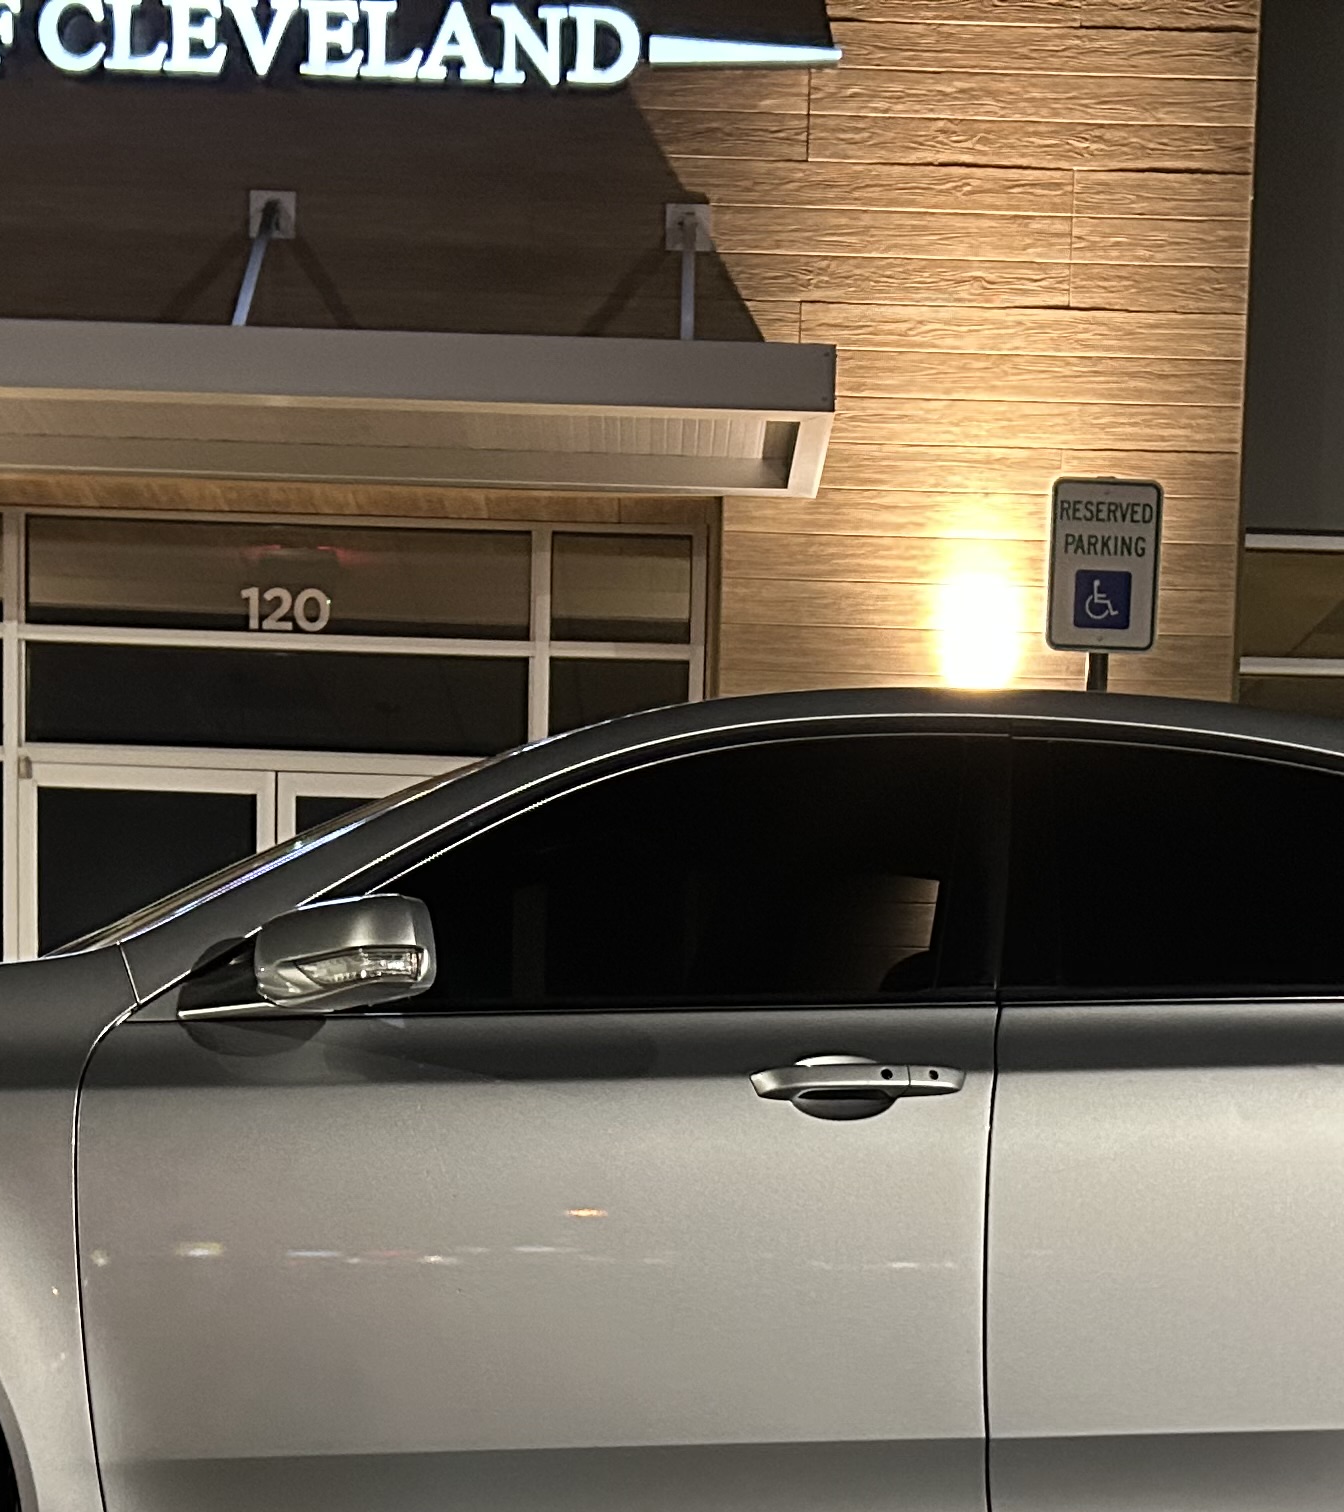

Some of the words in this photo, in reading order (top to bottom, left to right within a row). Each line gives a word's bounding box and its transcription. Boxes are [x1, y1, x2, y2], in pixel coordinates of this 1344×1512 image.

[37, 0, 641, 86] CLEVELAND
[1059, 499, 1153, 524] RESERVED
[1064, 533, 1146, 558] PARKING
[240, 586, 331, 633] 120
